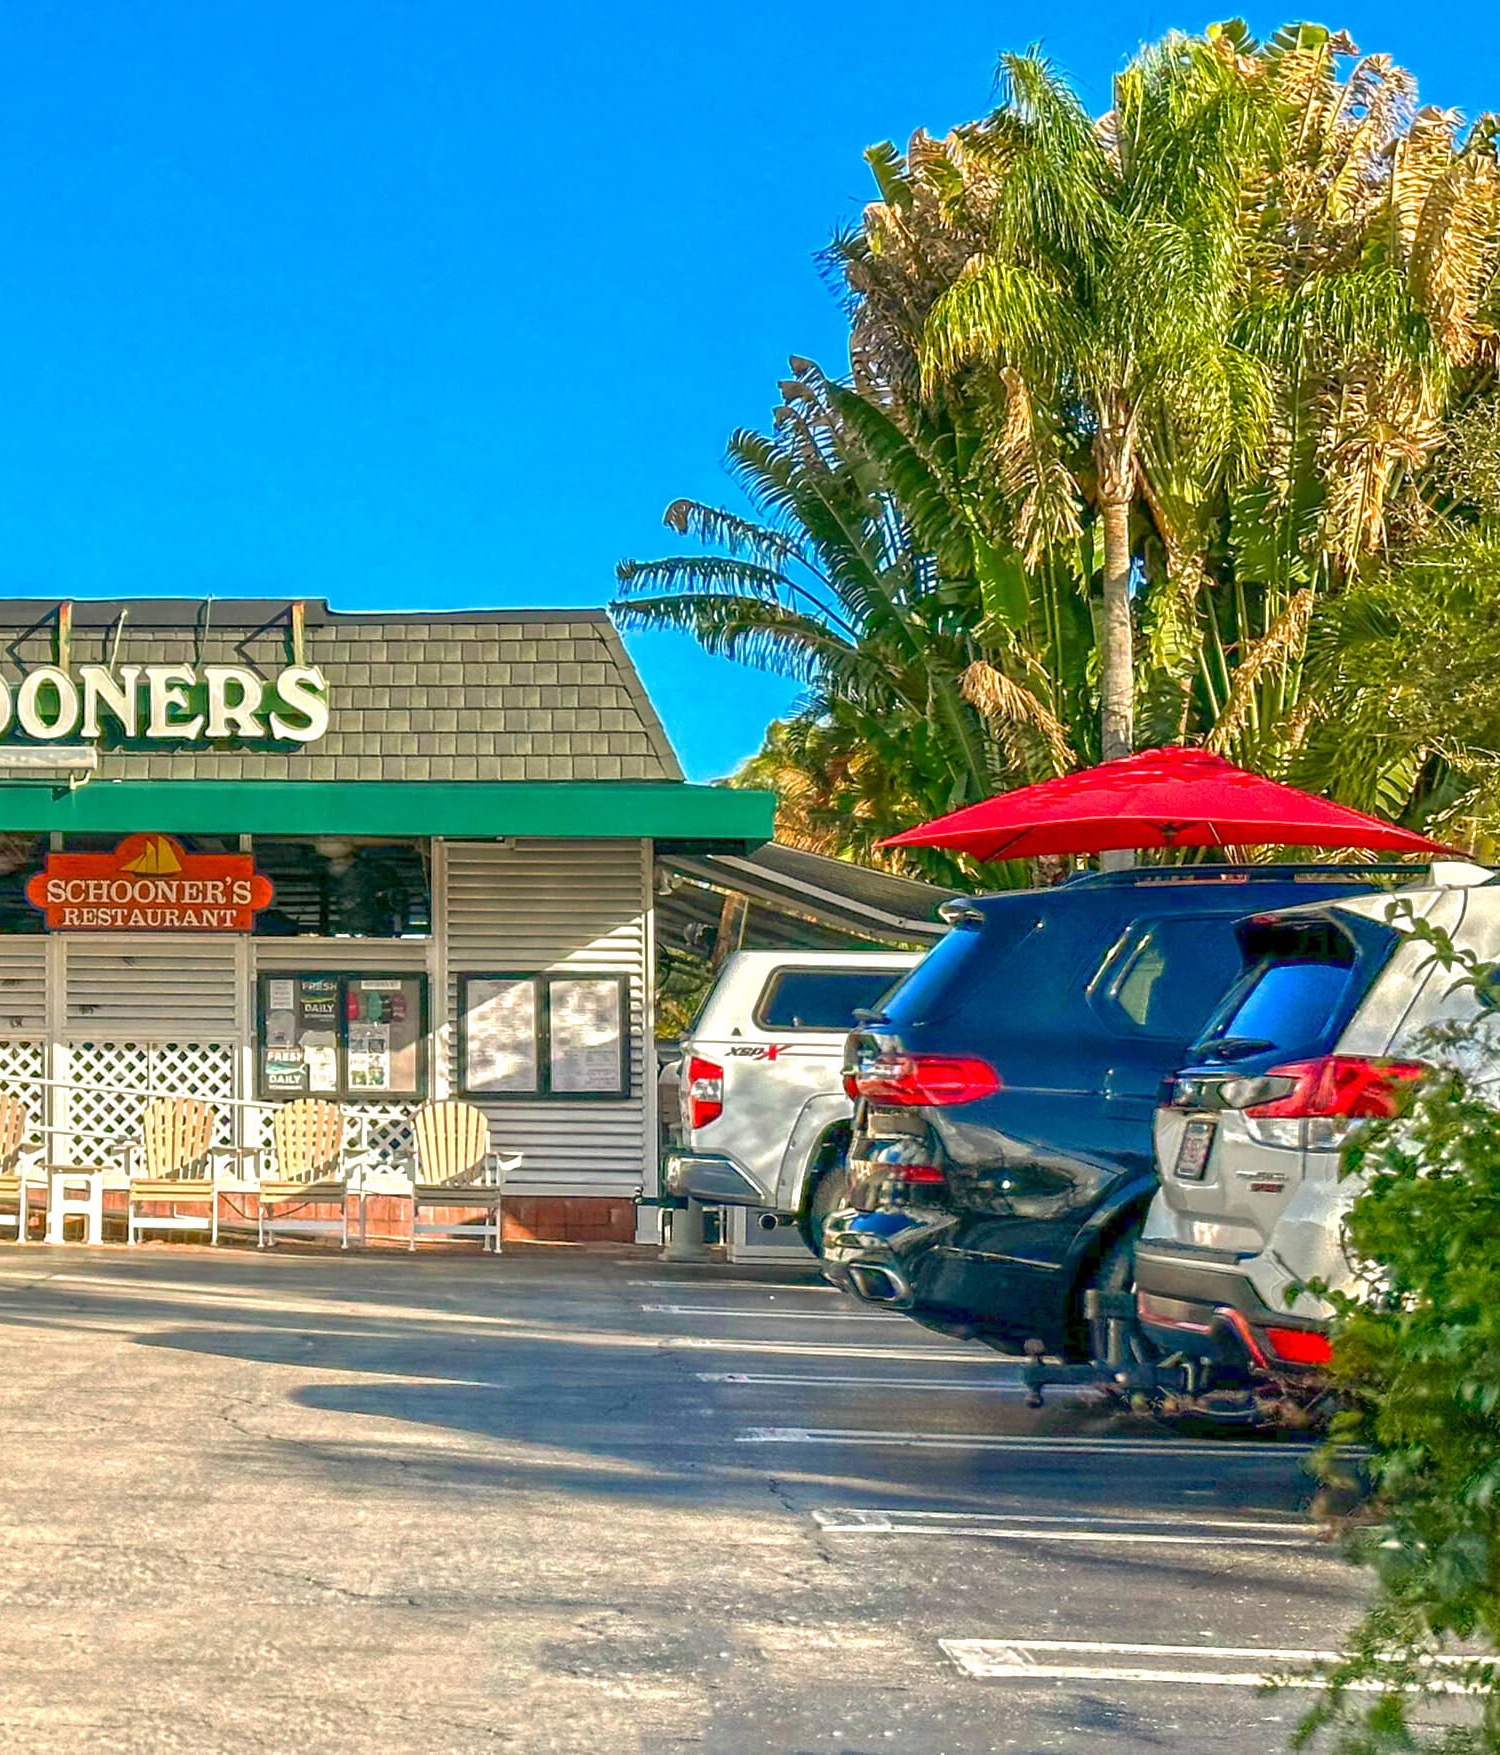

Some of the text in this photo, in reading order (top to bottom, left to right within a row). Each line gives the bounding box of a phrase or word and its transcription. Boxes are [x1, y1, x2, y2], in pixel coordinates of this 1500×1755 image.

[47, 876, 252, 904] SCHOONER'S
[62, 908, 237, 927] RESTAURANT
[302, 981, 337, 991] FRESH
[304, 1004, 334, 1012] DAILY
[269, 1075, 301, 1084] DAILY
